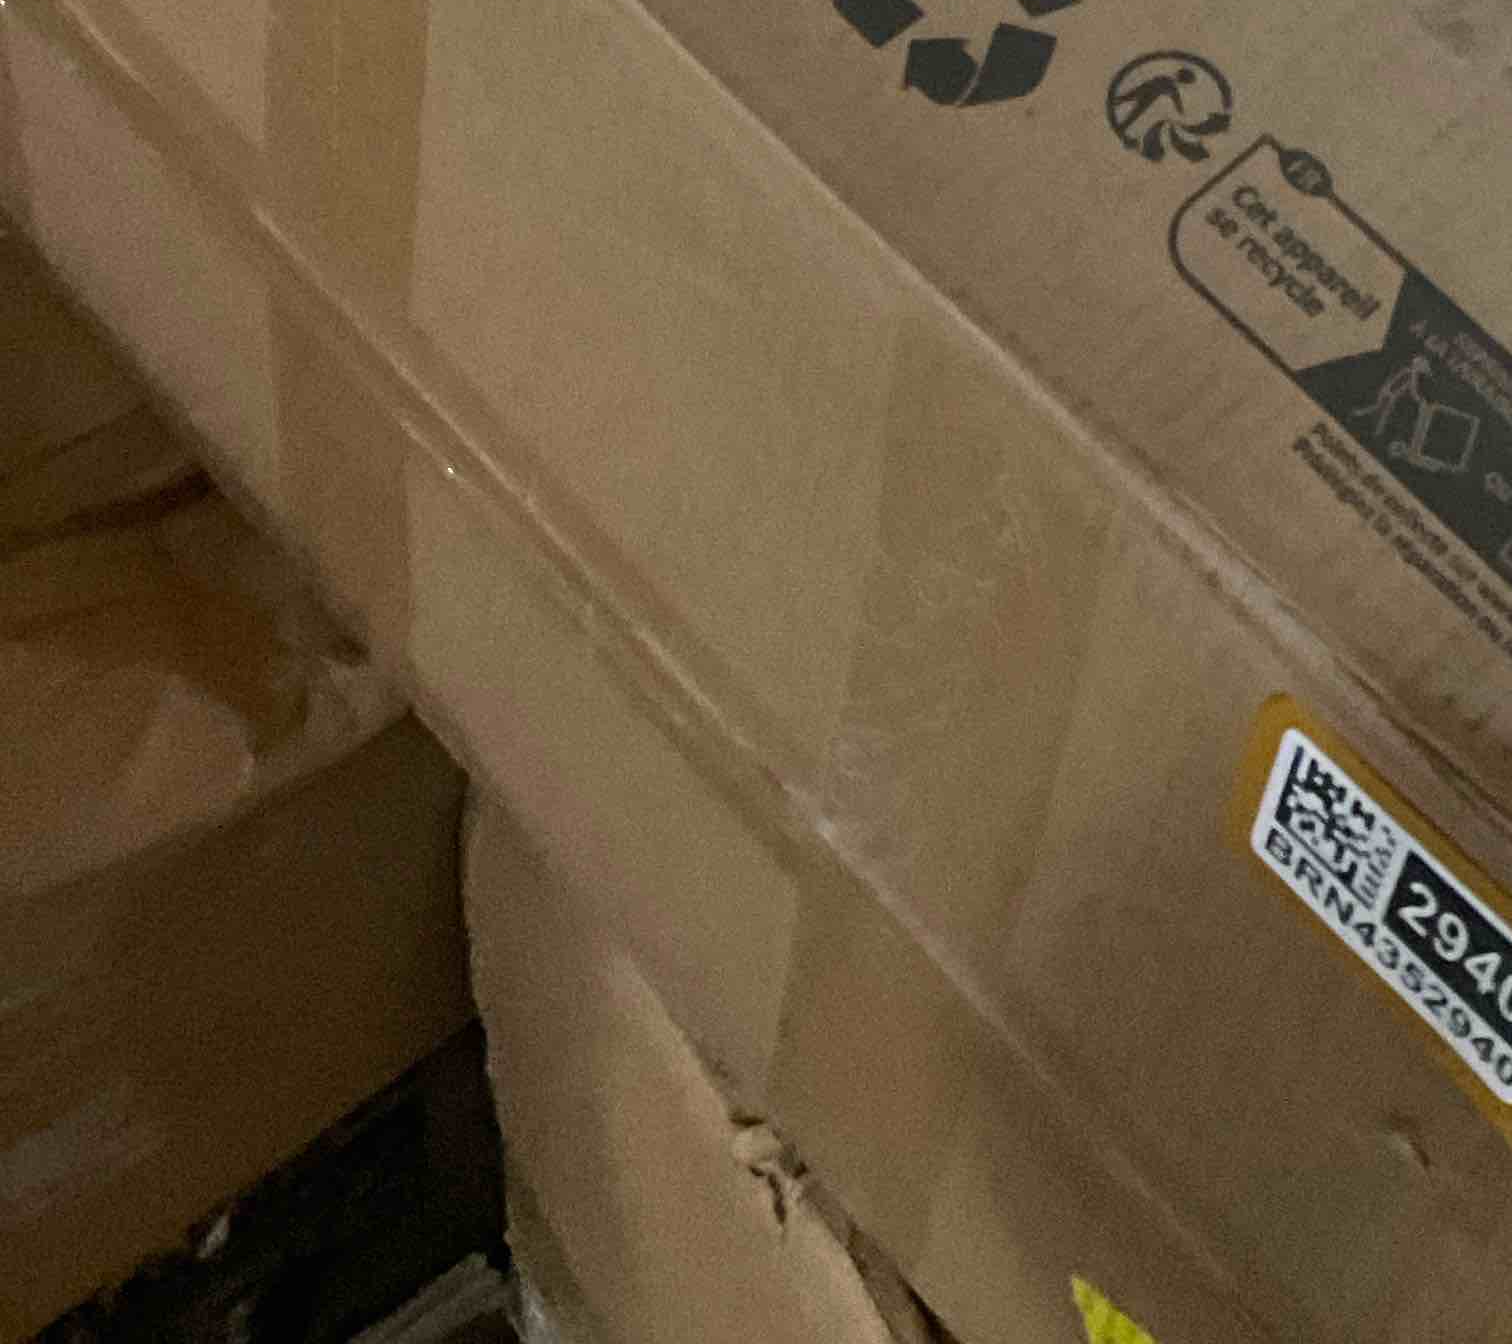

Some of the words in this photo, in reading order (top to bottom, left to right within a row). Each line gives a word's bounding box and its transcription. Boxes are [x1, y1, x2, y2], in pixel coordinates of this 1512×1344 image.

[1228, 181, 1282, 232] Cet
[1269, 222, 1383, 321] appareil
[1235, 233, 1327, 318] recycle
